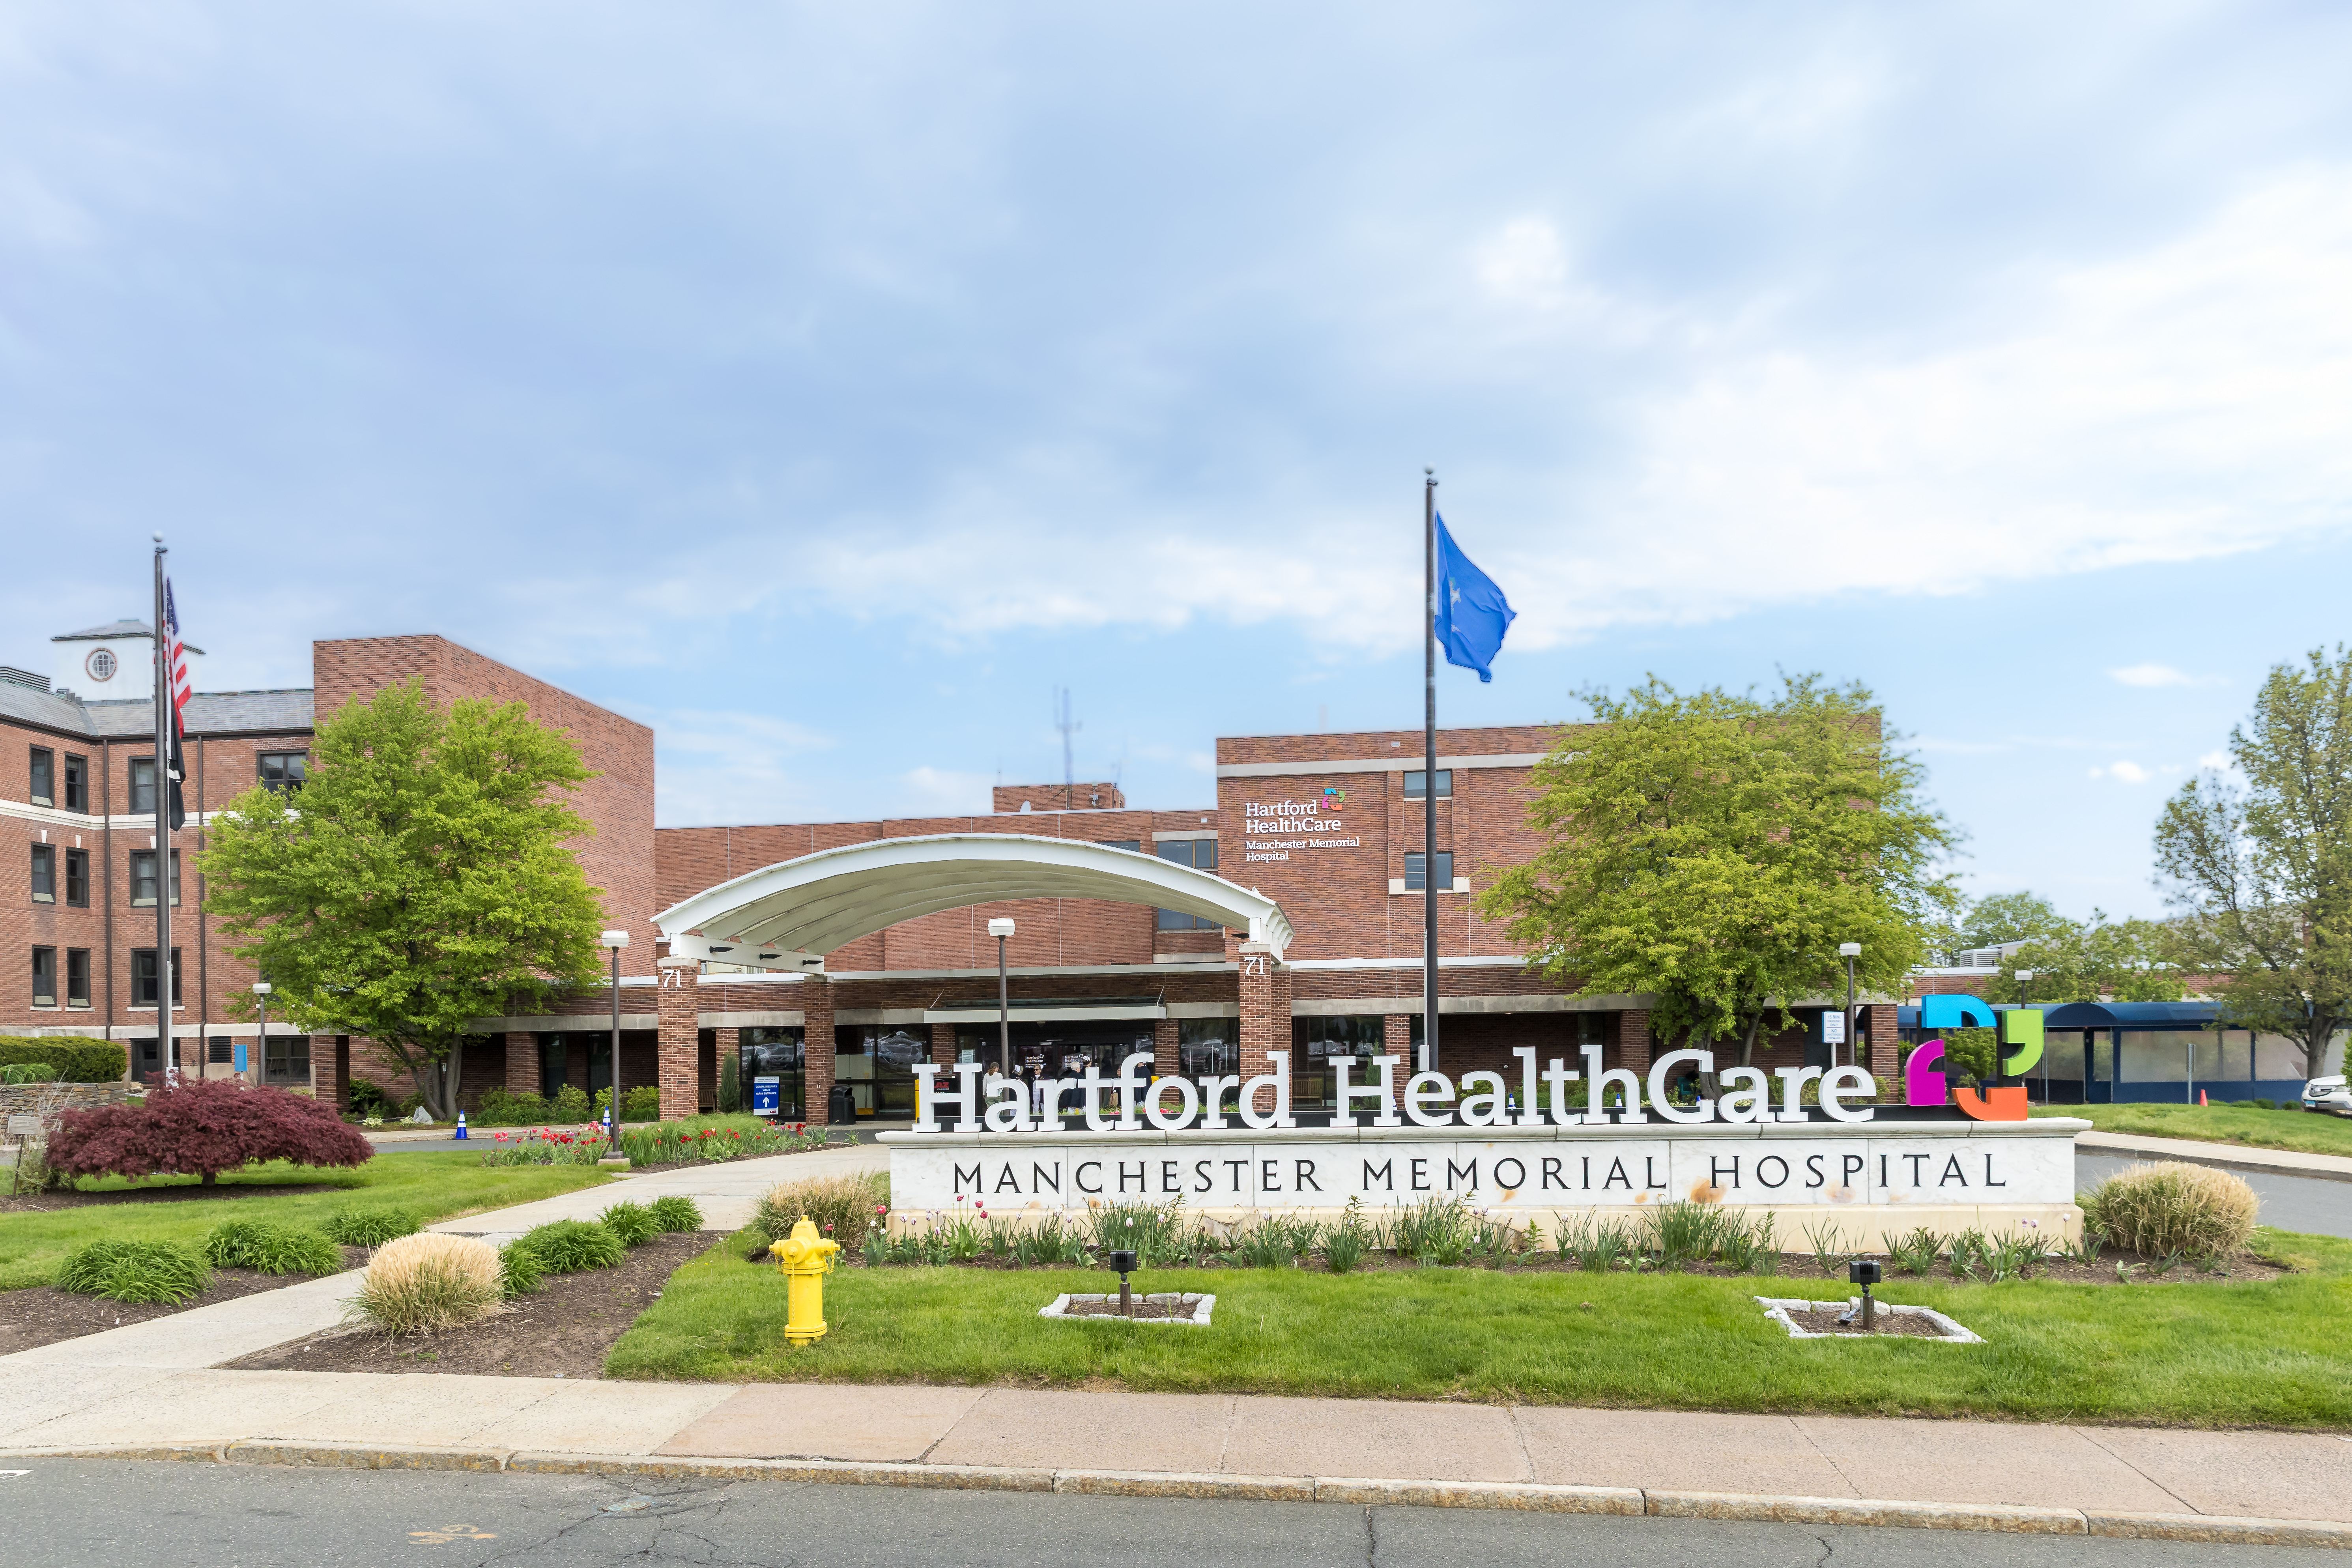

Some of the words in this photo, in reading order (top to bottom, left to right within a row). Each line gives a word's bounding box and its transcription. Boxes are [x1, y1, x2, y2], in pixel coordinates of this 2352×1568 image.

[1245, 799, 1318, 817] Hartford
[1245, 817, 1341, 834] HealthCare
[1245, 839, 1307, 850] Manchester
[1309, 837, 1360, 848] Memorial
[1245, 850, 1289, 863] Hospital
[1244, 956, 1265, 975] 71
[662, 969, 682, 988] 71
[912, 1050, 1296, 1133] Hartford
[1329, 1045, 1877, 1127] HealthCare
[954, 1160, 1324, 1194] MANCHESTER
[1363, 1156, 1667, 1190] MEMORIAL
[1710, 1153, 2006, 1189] HOSPITAL
